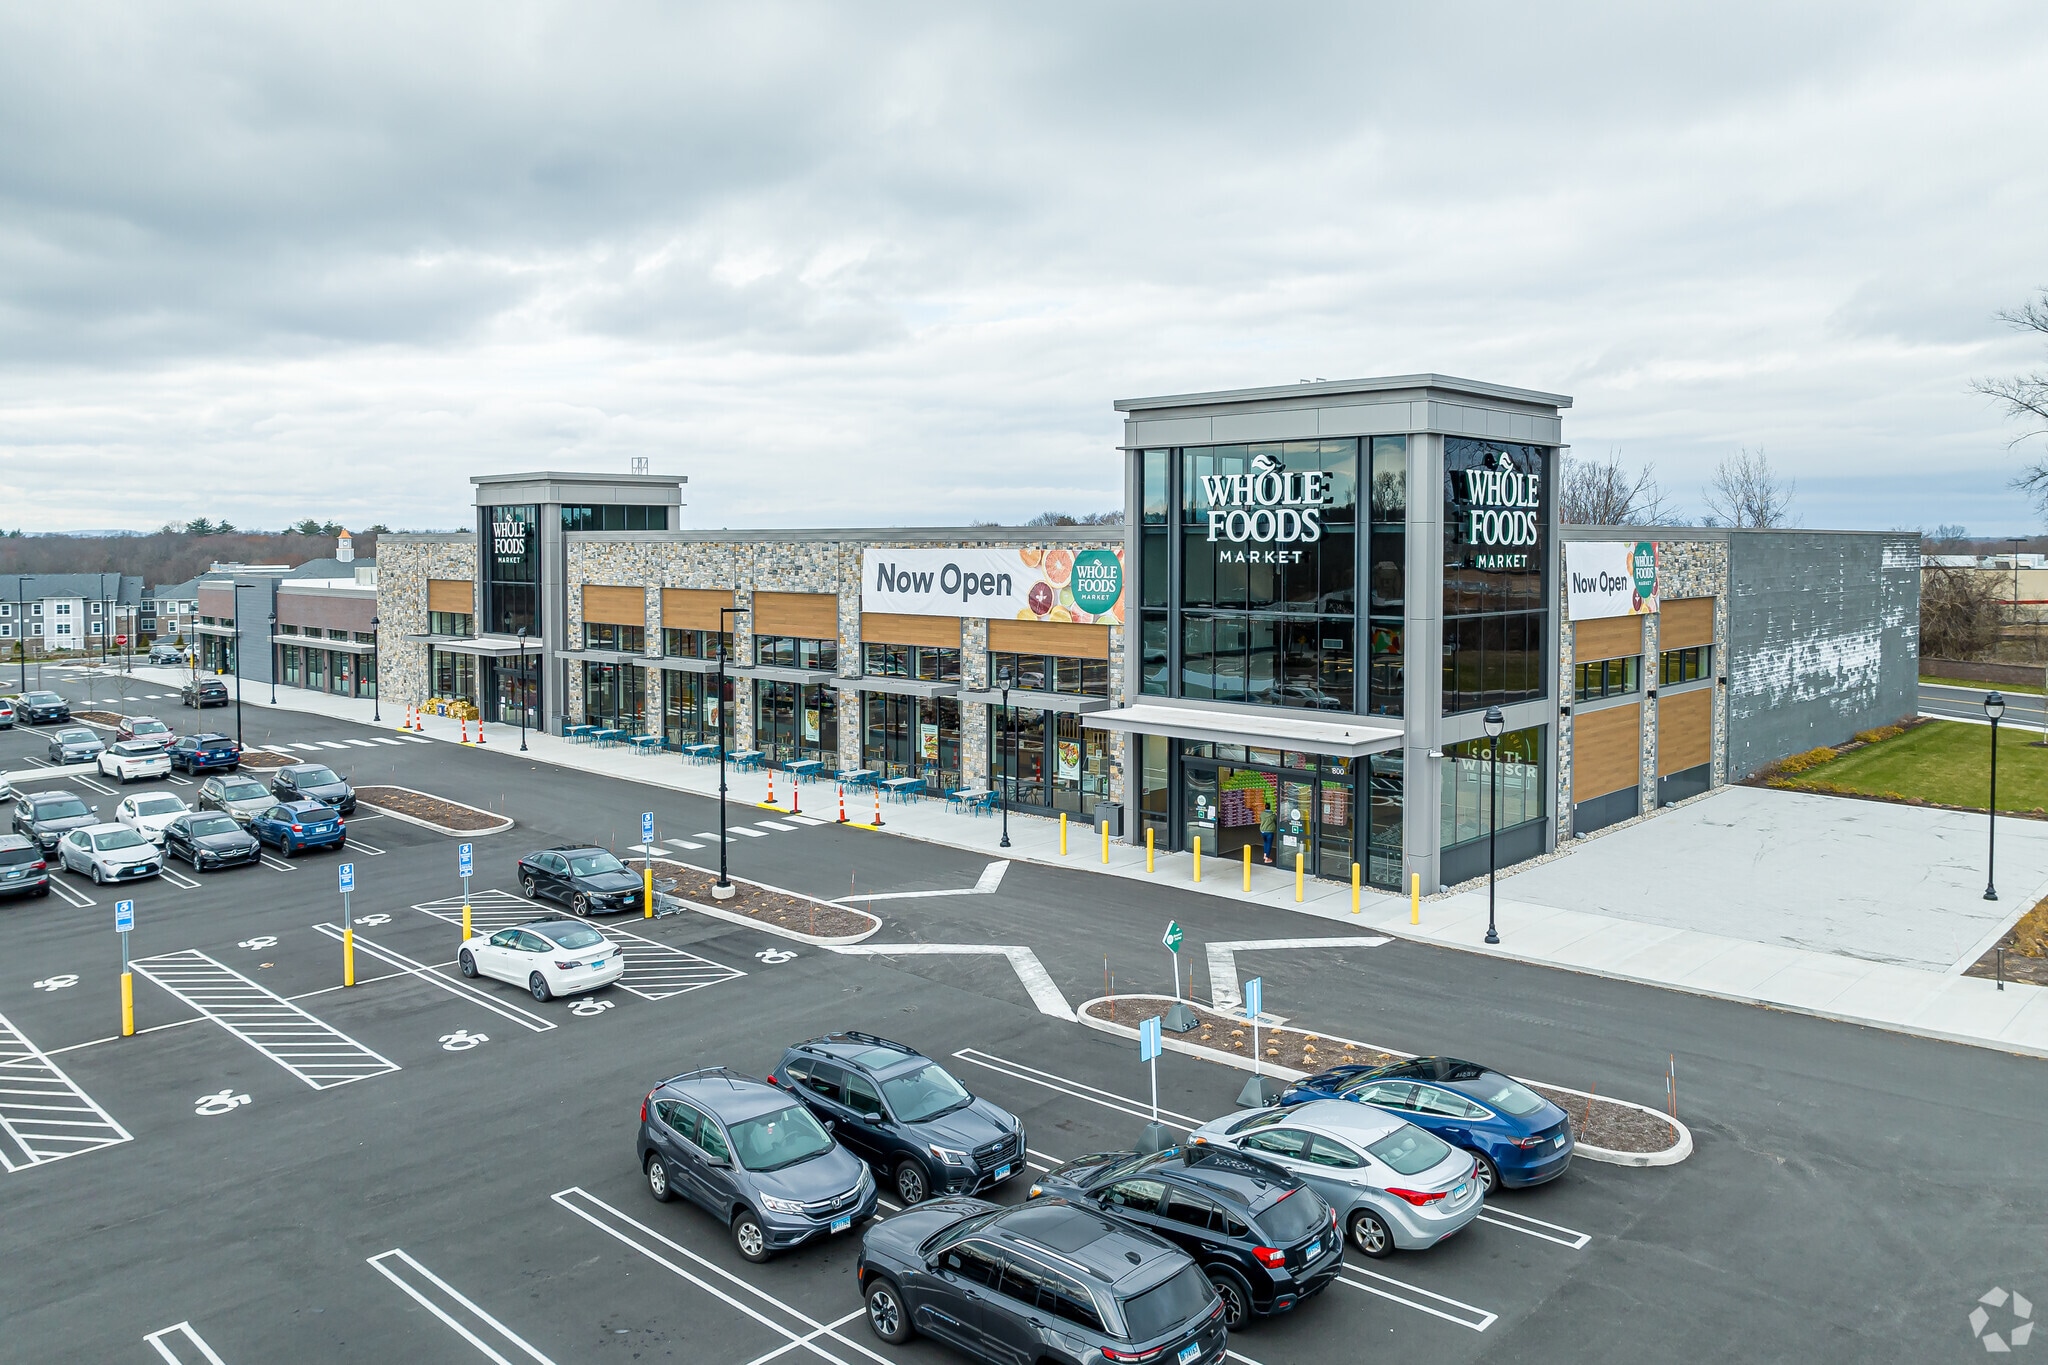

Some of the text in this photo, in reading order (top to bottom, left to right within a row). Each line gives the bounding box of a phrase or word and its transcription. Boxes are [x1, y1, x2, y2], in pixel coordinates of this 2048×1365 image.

[1200, 470, 1324, 506] WHOLE
[1466, 469, 1540, 507] WHOLE
[492, 521, 526, 538] WHOLE
[1206, 508, 1321, 543] FOODS
[1470, 510, 1538, 546] FOODS
[494, 538, 525, 554] FOODS
[497, 556, 520, 564] MARKET
[1219, 550, 1303, 564] MARKET
[1477, 554, 1528, 568] MARKET
[1634, 555, 1655, 567] WHOLE
[1076, 565, 1118, 579] WHOLE
[1635, 567, 1655, 579] FOODS
[876, 562, 1012, 603] Now Open
[1077, 579, 1116, 593] FOODS
[1572, 571, 1627, 597] Now Open
